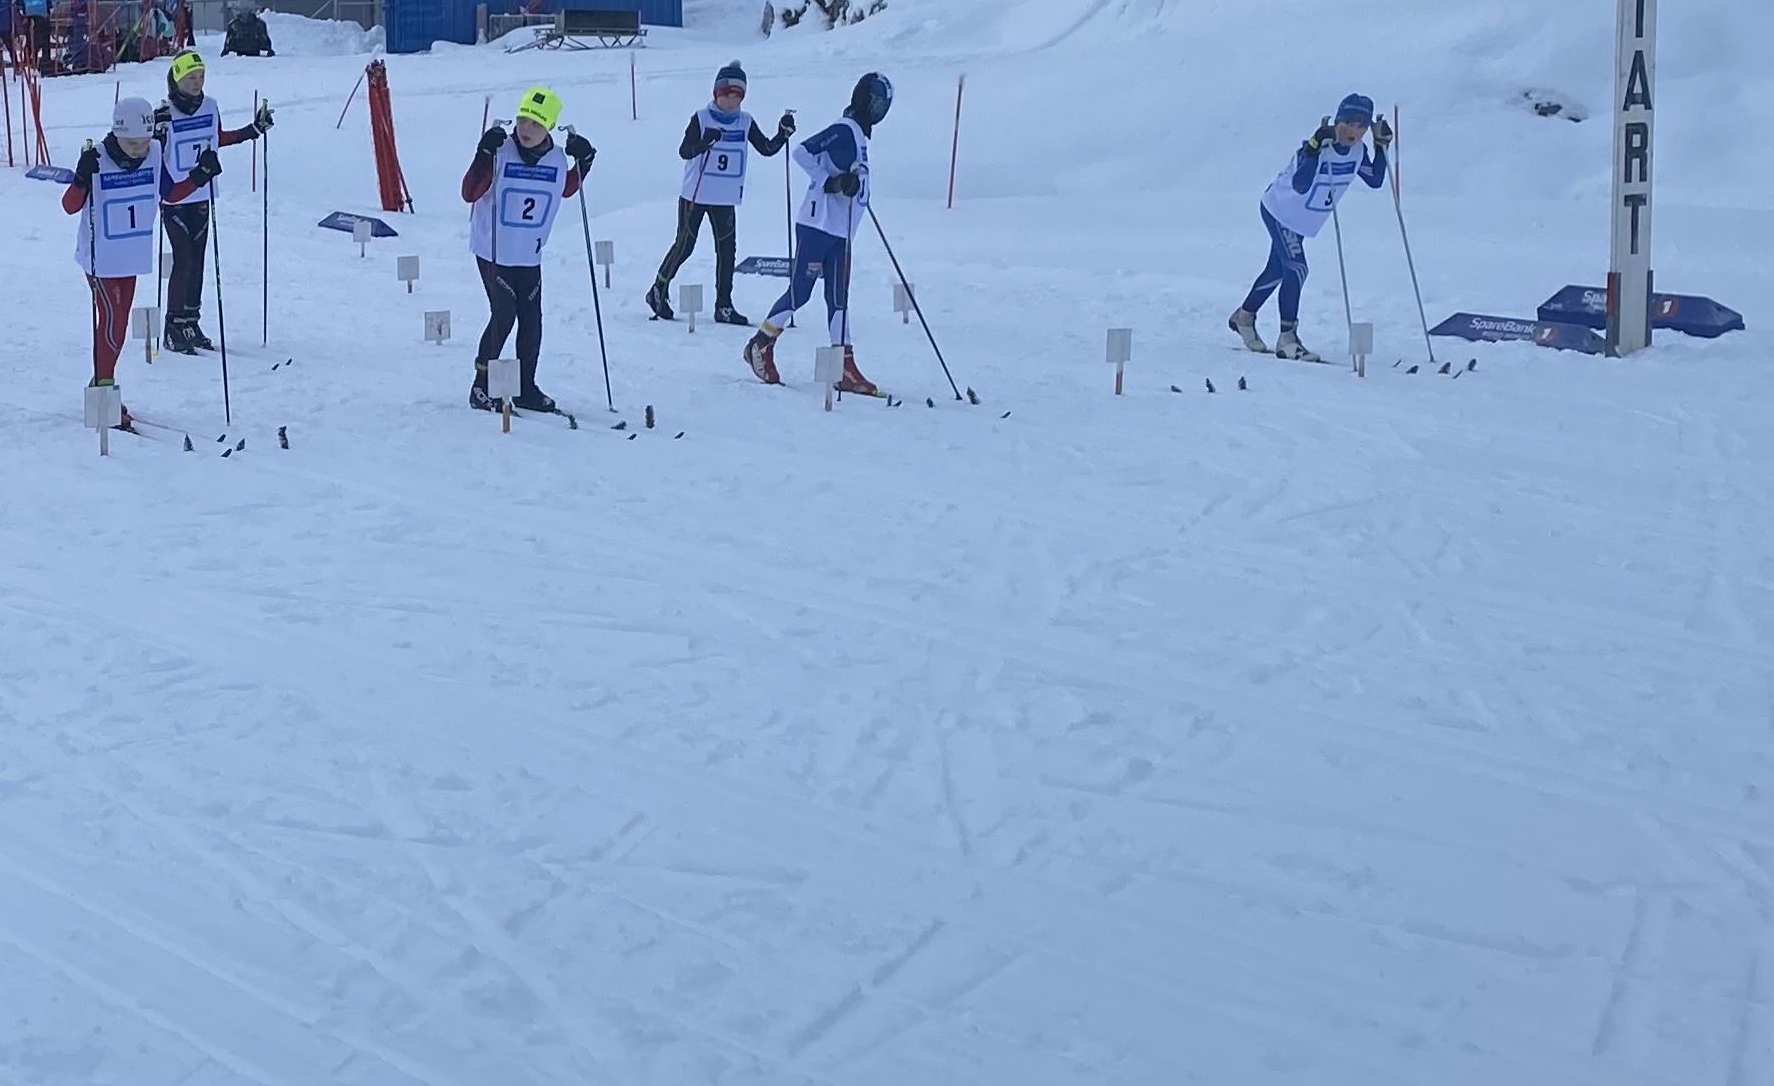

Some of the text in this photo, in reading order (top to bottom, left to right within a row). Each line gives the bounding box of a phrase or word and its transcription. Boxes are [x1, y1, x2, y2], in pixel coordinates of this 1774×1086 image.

[717, 154, 729, 171] 9
[127, 204, 136, 229] 1
[521, 197, 536, 220] 2
[1469, 317, 1536, 334] SpareBank
